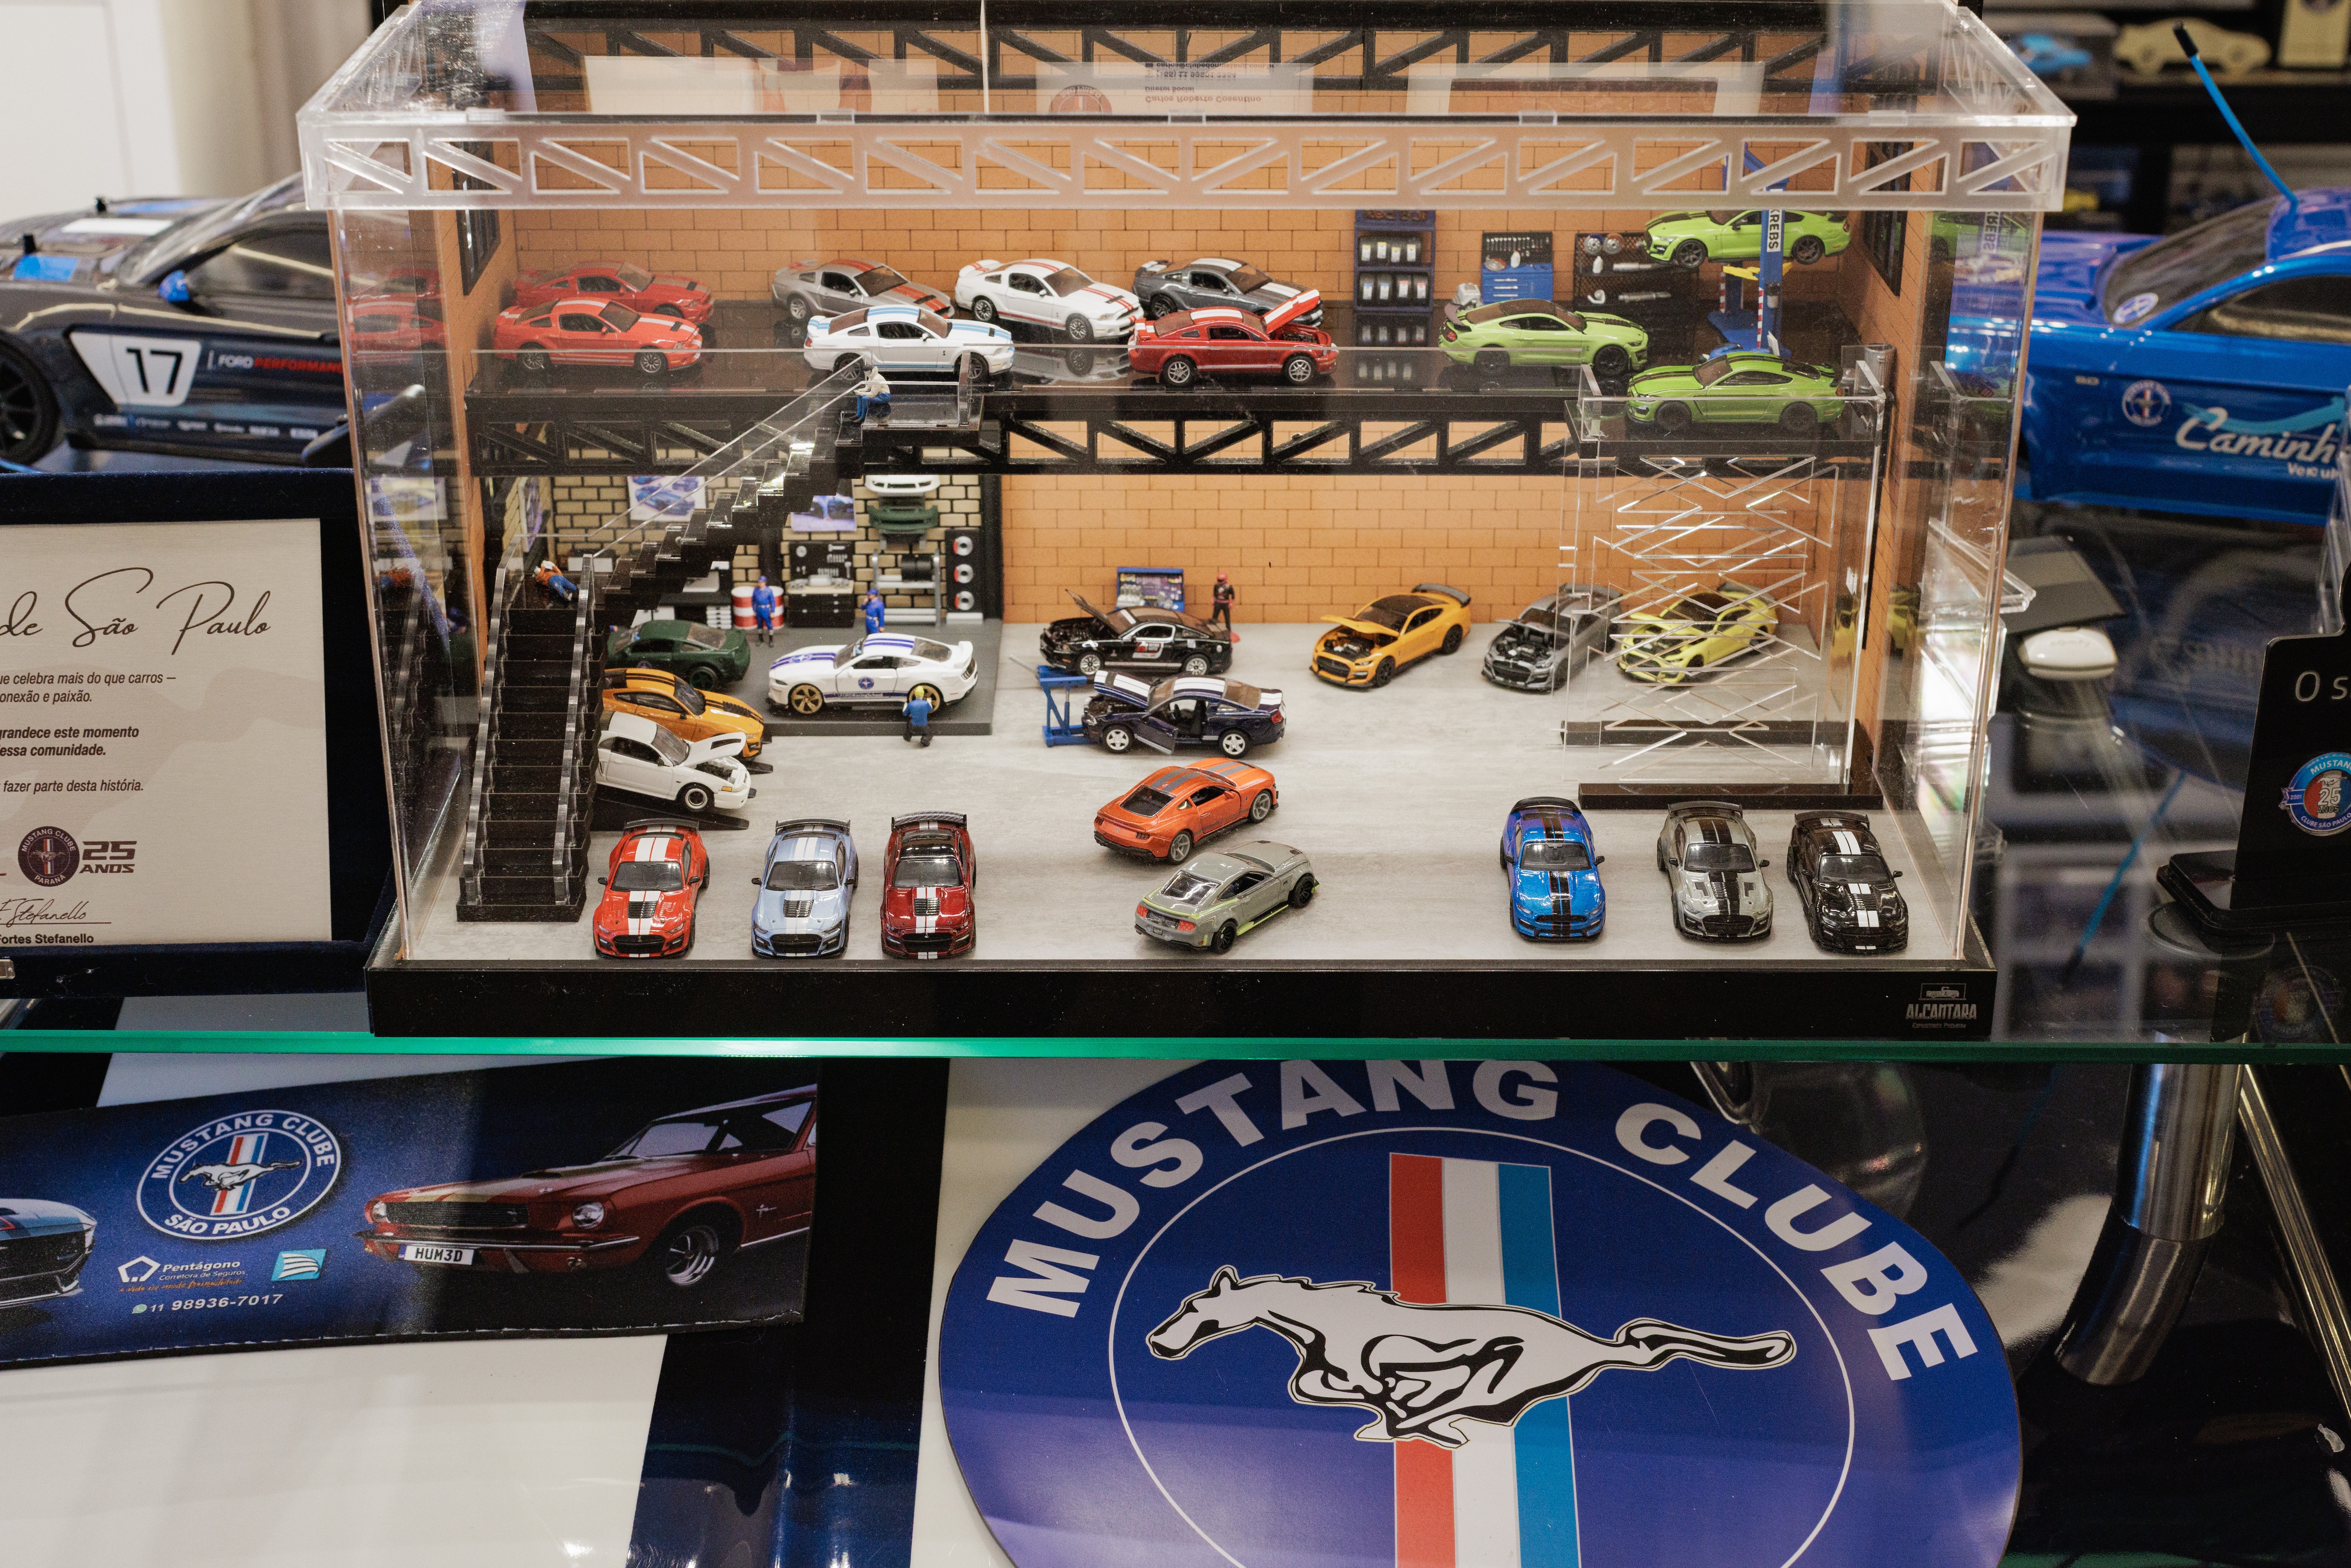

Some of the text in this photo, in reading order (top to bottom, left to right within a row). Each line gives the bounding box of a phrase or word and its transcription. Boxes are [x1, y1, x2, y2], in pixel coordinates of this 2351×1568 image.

[219, 355, 254, 369] FORD
[126, 347, 183, 394] 17
[2175, 407, 2337, 464] Caminh
[65, 567, 154, 647] São
[156, 581, 271, 655] Paulo
[14, 673, 54, 684] celebra
[57, 673, 84, 684] mais
[87, 672, 101, 684] do
[104, 674, 125, 686] que
[128, 674, 163, 684] carros
[43, 693, 49, 702] e
[53, 690, 92, 704] paixão.
[54, 727, 79, 738] este
[83, 726, 139, 738] momento
[0, 744, 106, 756] essa comunidade.
[2310, 760, 2351, 775] MUSTAN
[3, 779, 143, 794] fazer parte desta história.
[2318, 788, 2342, 806] 25
[2316, 805, 2339, 814] ANOS
[2301, 816, 2319, 827] CLUBE
[22, 828, 76, 852] MUSTANG CLUBE
[82, 841, 137, 860] 25
[79, 864, 135, 874] ANOS
[35, 933, 94, 944] Stefanello
[1906, 1004, 1977, 1019] ALCANTARA
[152, 1113, 334, 1179] MUSTANG CLUBE
[165, 1206, 292, 1235] SÃO PAULO
[986, 1060, 1978, 1381] MUSTANG CLUBE
[415, 1247, 463, 1262] HUM3D
[162, 1261, 240, 1272] Pentágono
[171, 1294, 283, 1311] 98936-7017
